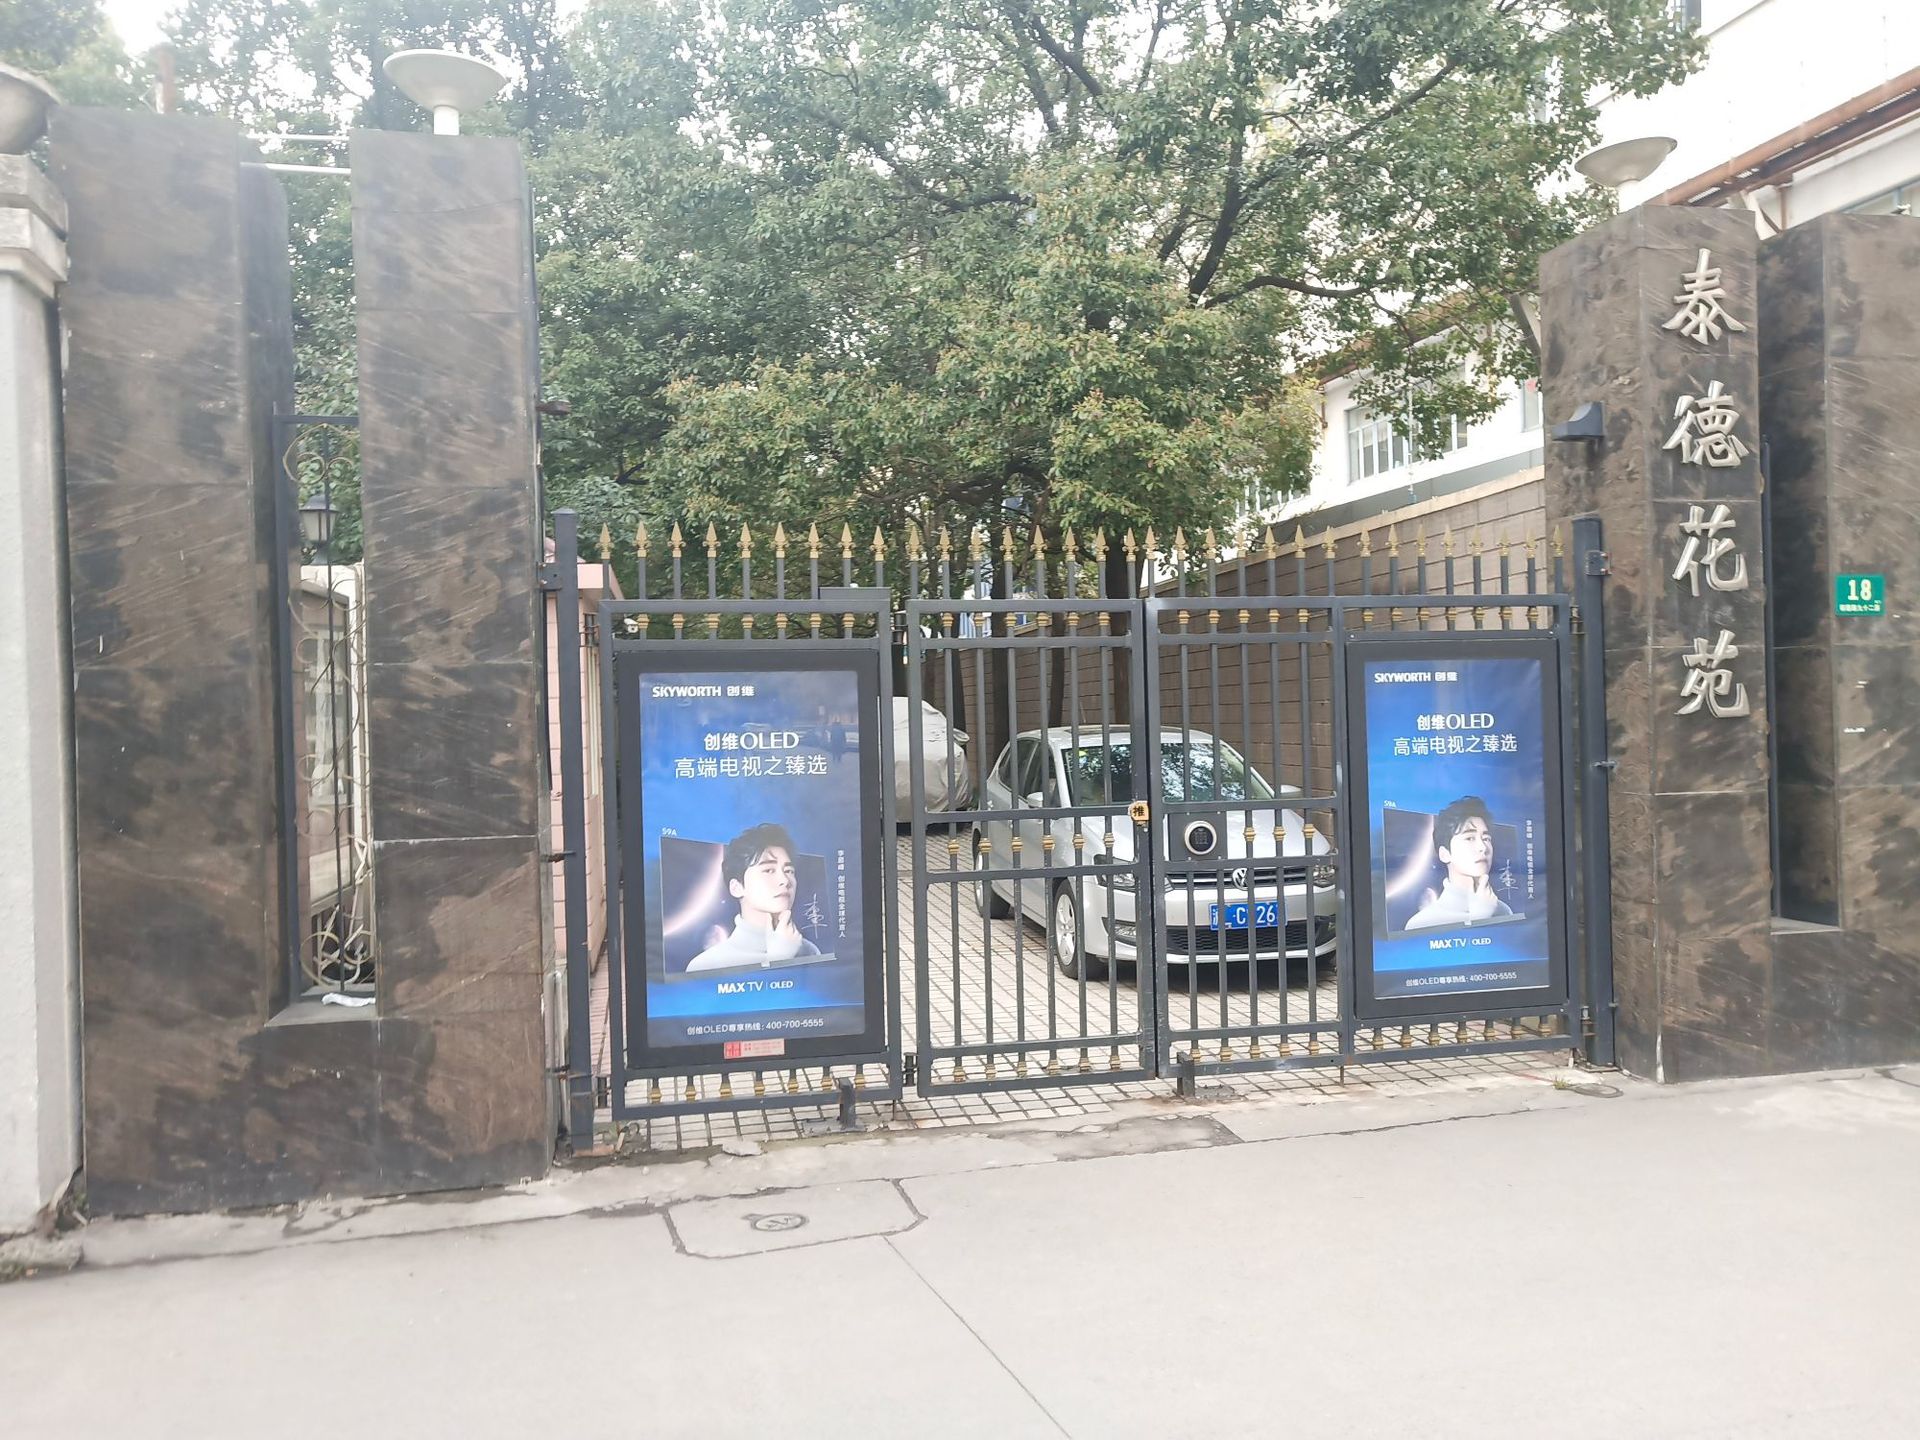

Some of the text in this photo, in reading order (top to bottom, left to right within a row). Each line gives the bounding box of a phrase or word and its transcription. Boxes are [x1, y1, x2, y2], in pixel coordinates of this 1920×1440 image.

[1662, 248, 1751, 719] 泰德花苑
[1847, 579, 1873, 601] 18
[1374, 671, 1458, 683] SKYWORTH 创维
[652, 685, 756, 698] SKYWORTH 创维
[1416, 712, 1495, 731] 创维OLED
[704, 731, 800, 751] 创维OLED
[1393, 733, 1518, 757] 高端电视之臻选
[674, 754, 828, 779] 高端电视之臻选
[1132, 805, 1145, 817] 推
[1429, 938, 1492, 950] MAX TV OLED
[717, 980, 794, 994] MAX TV OLED
